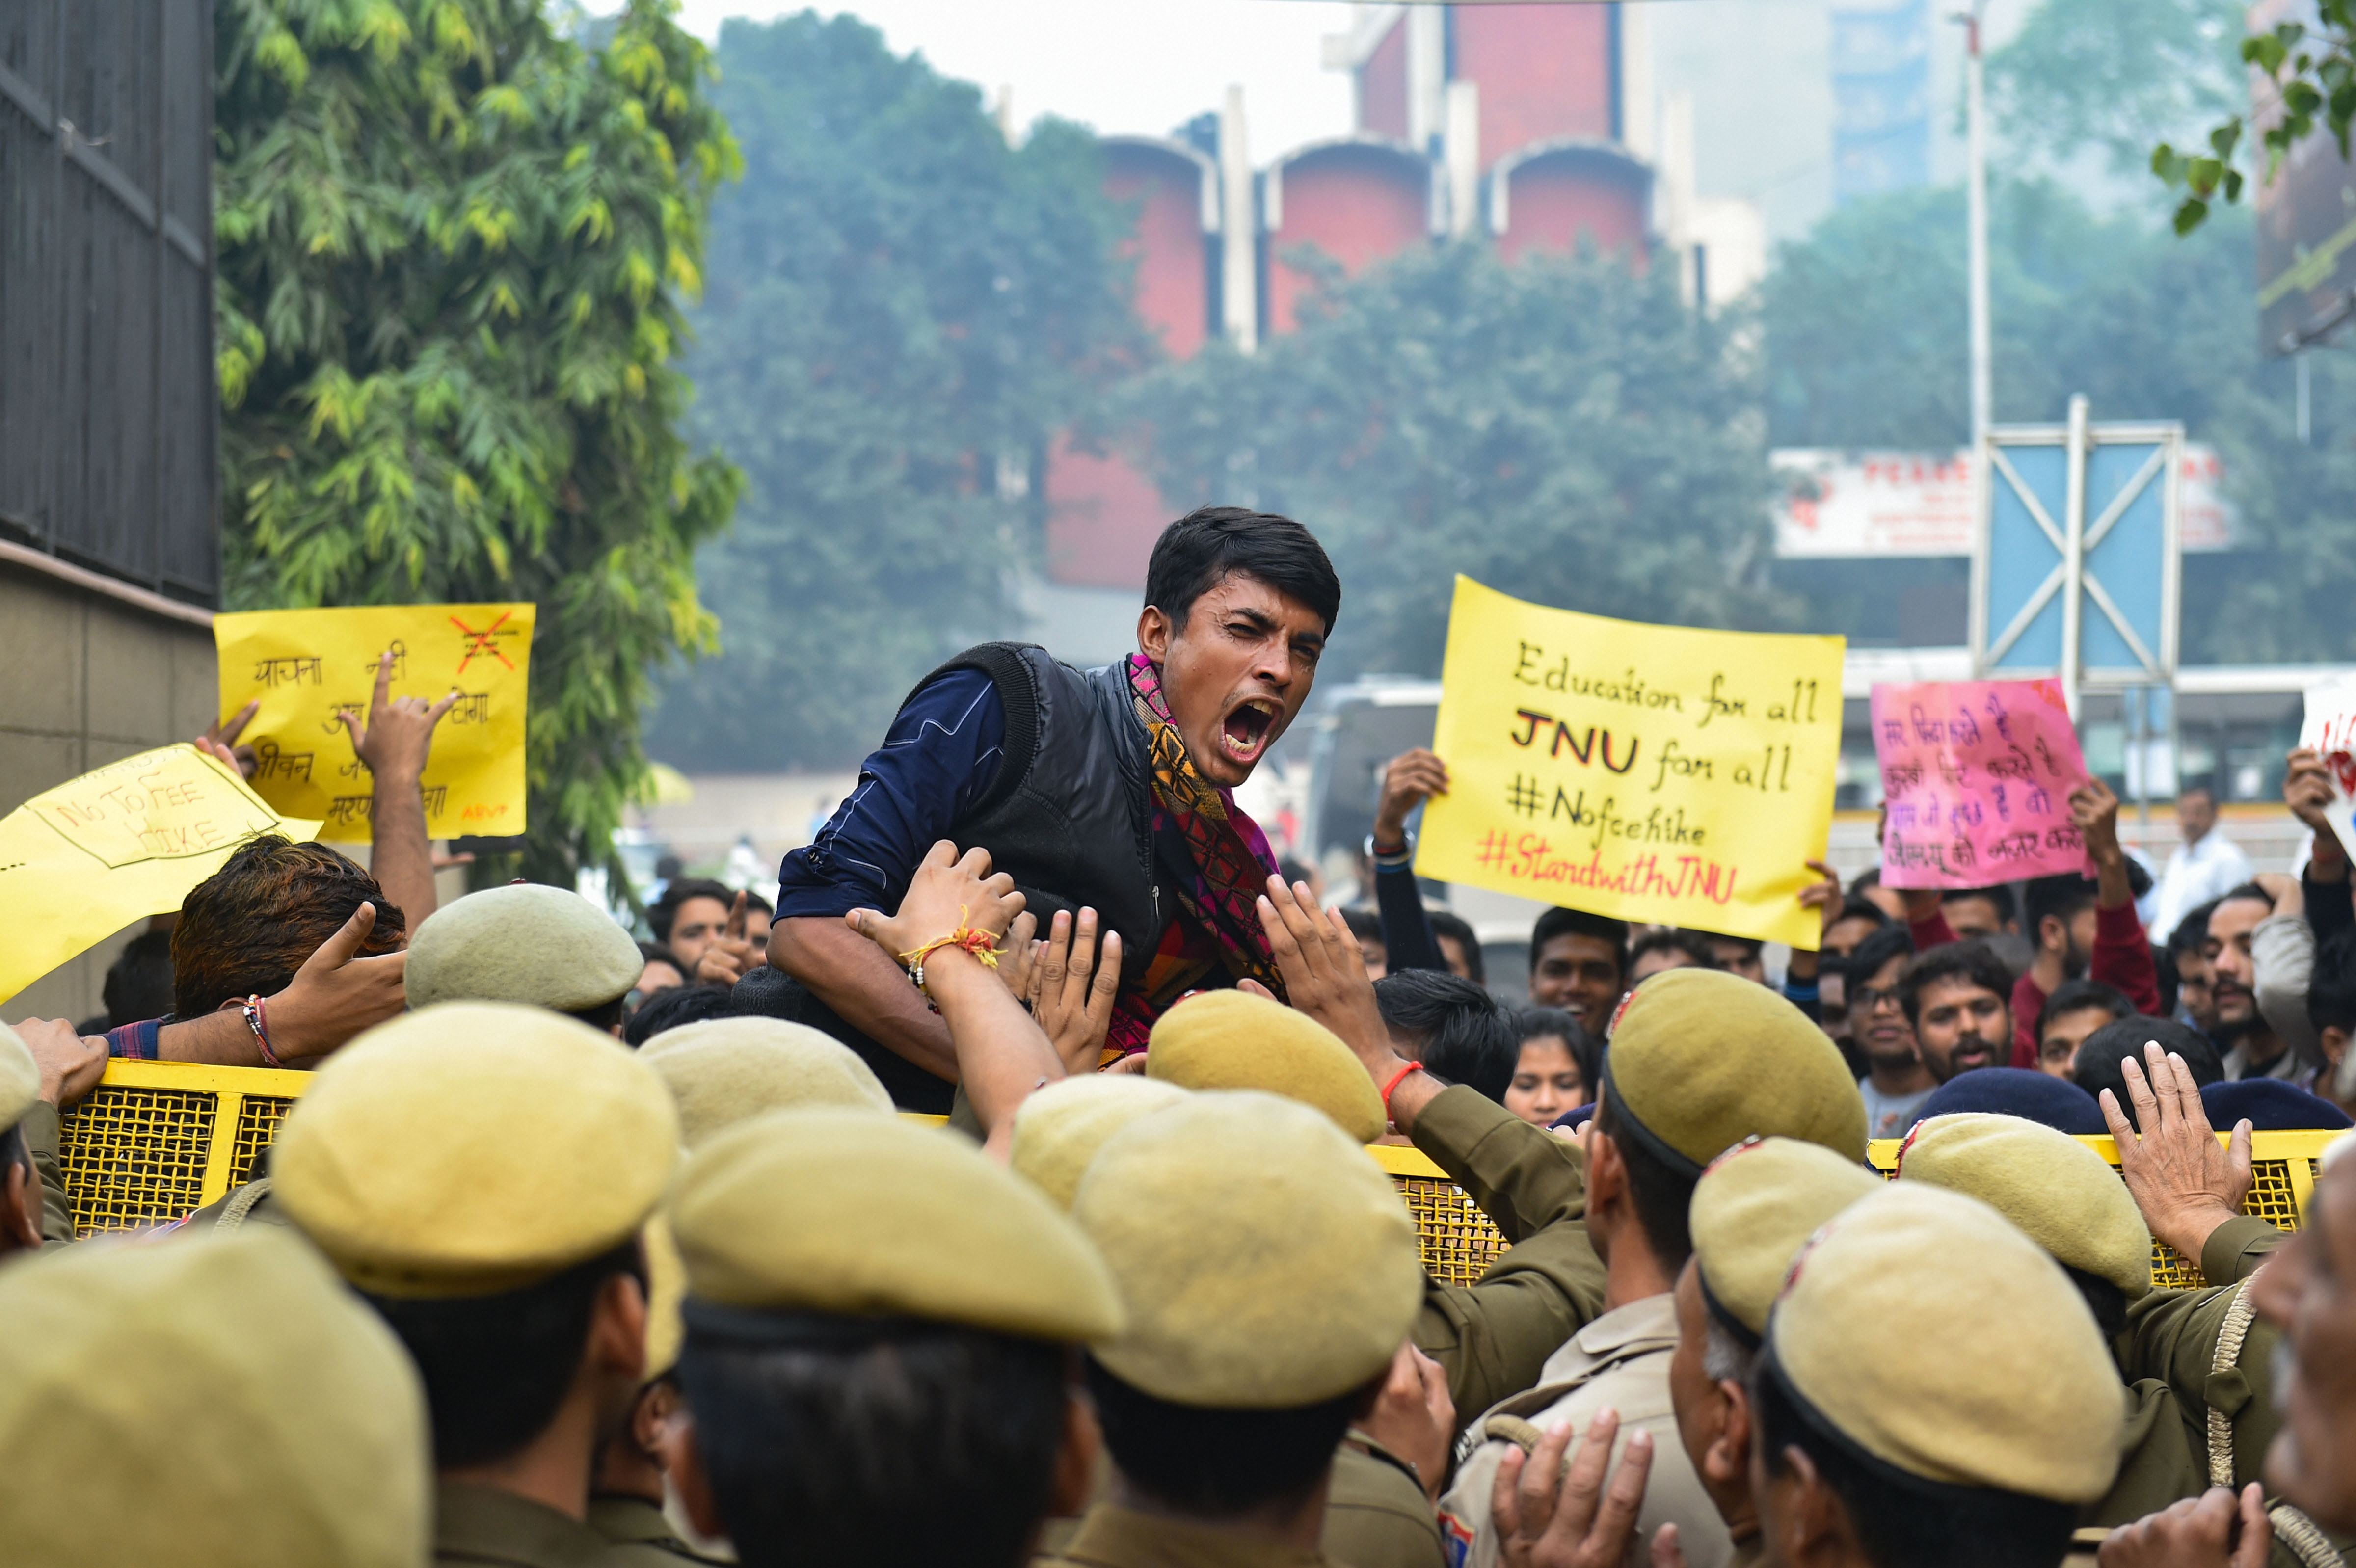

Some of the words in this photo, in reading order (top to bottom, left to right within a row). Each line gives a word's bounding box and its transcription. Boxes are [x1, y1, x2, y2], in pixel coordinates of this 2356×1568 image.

[254, 657, 322, 688] याचना
[1514, 641, 1684, 713] Education
[1767, 680, 1818, 723] all
[1511, 707, 1639, 775] JNU
[1733, 745, 1791, 792] all
[100, 786, 146, 814] TO
[137, 771, 205, 810] FEE
[123, 815, 225, 853] HIKE
[1475, 828, 1738, 906] #StandwithJNU
